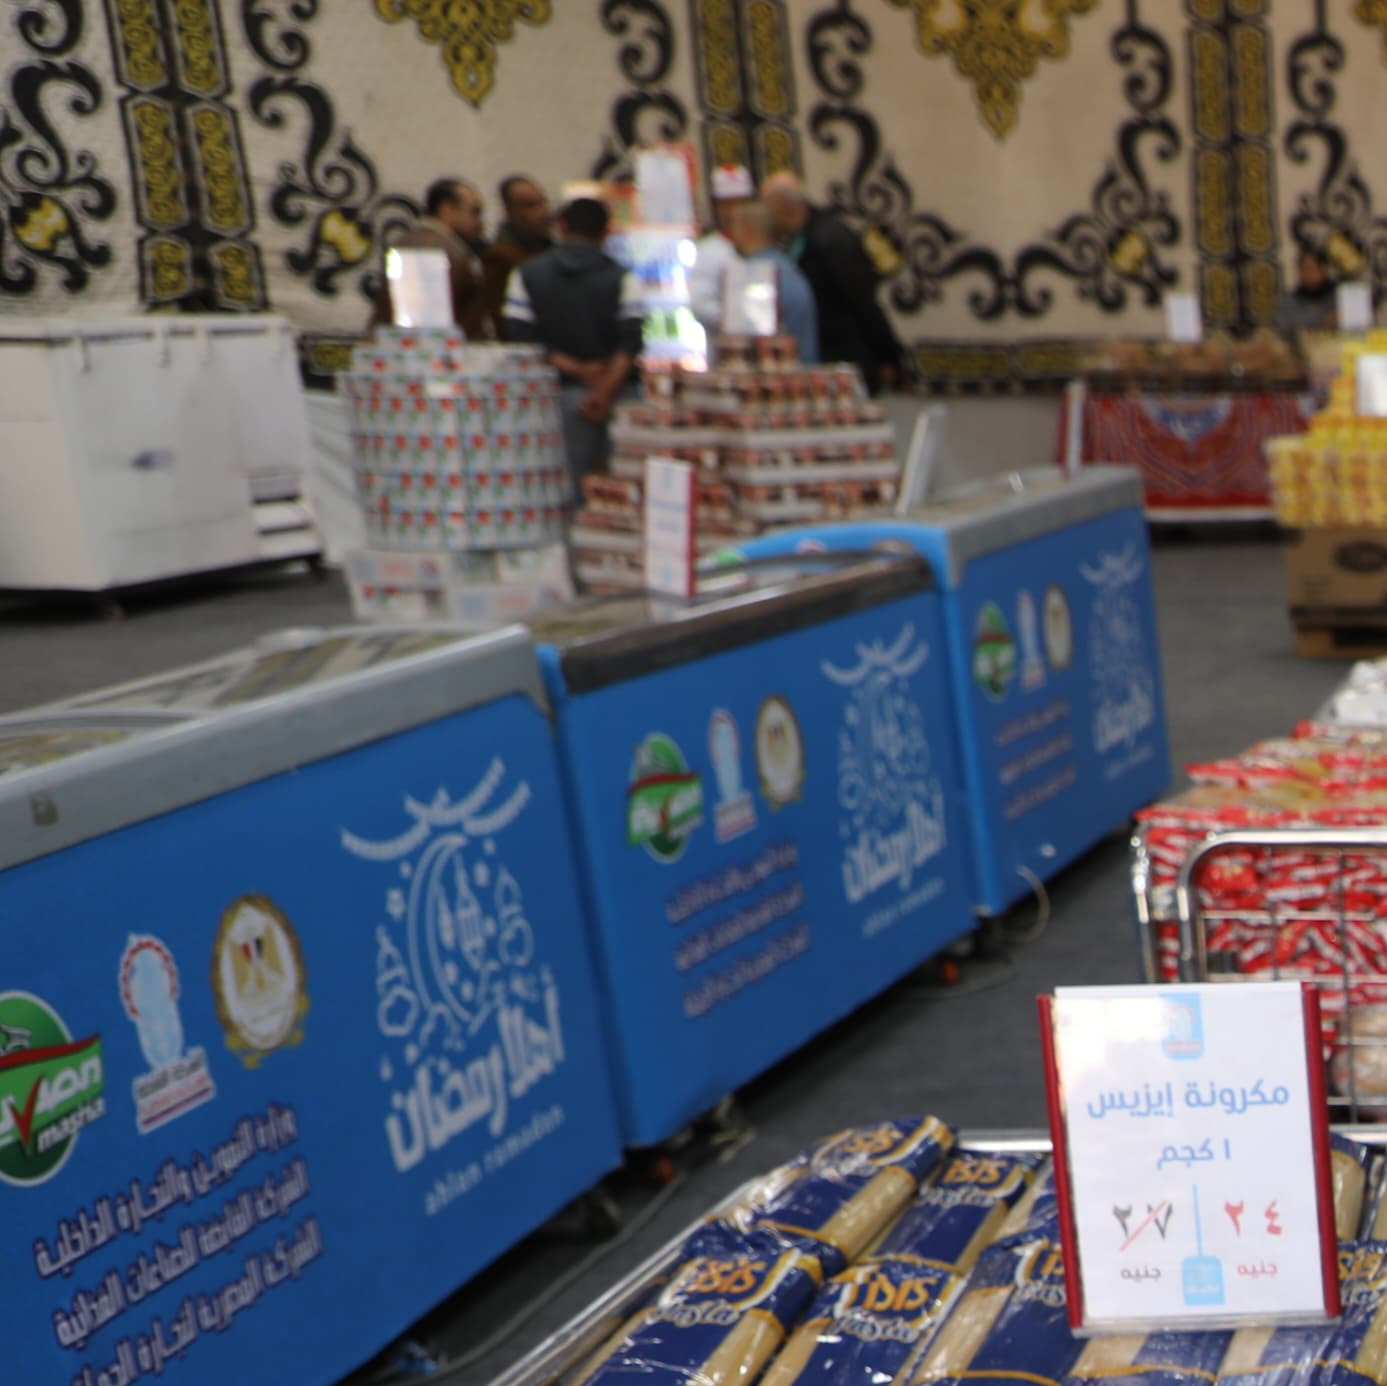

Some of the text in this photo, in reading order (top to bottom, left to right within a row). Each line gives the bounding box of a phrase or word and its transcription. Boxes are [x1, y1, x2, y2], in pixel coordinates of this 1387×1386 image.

[1087, 1079, 1289, 1118] مكرونة إيزيس
[1157, 1138, 1214, 1170] كجم
[35, 1197, 116, 1278] الداخلية
[1121, 1261, 1277, 1281] جنيه جنيه
